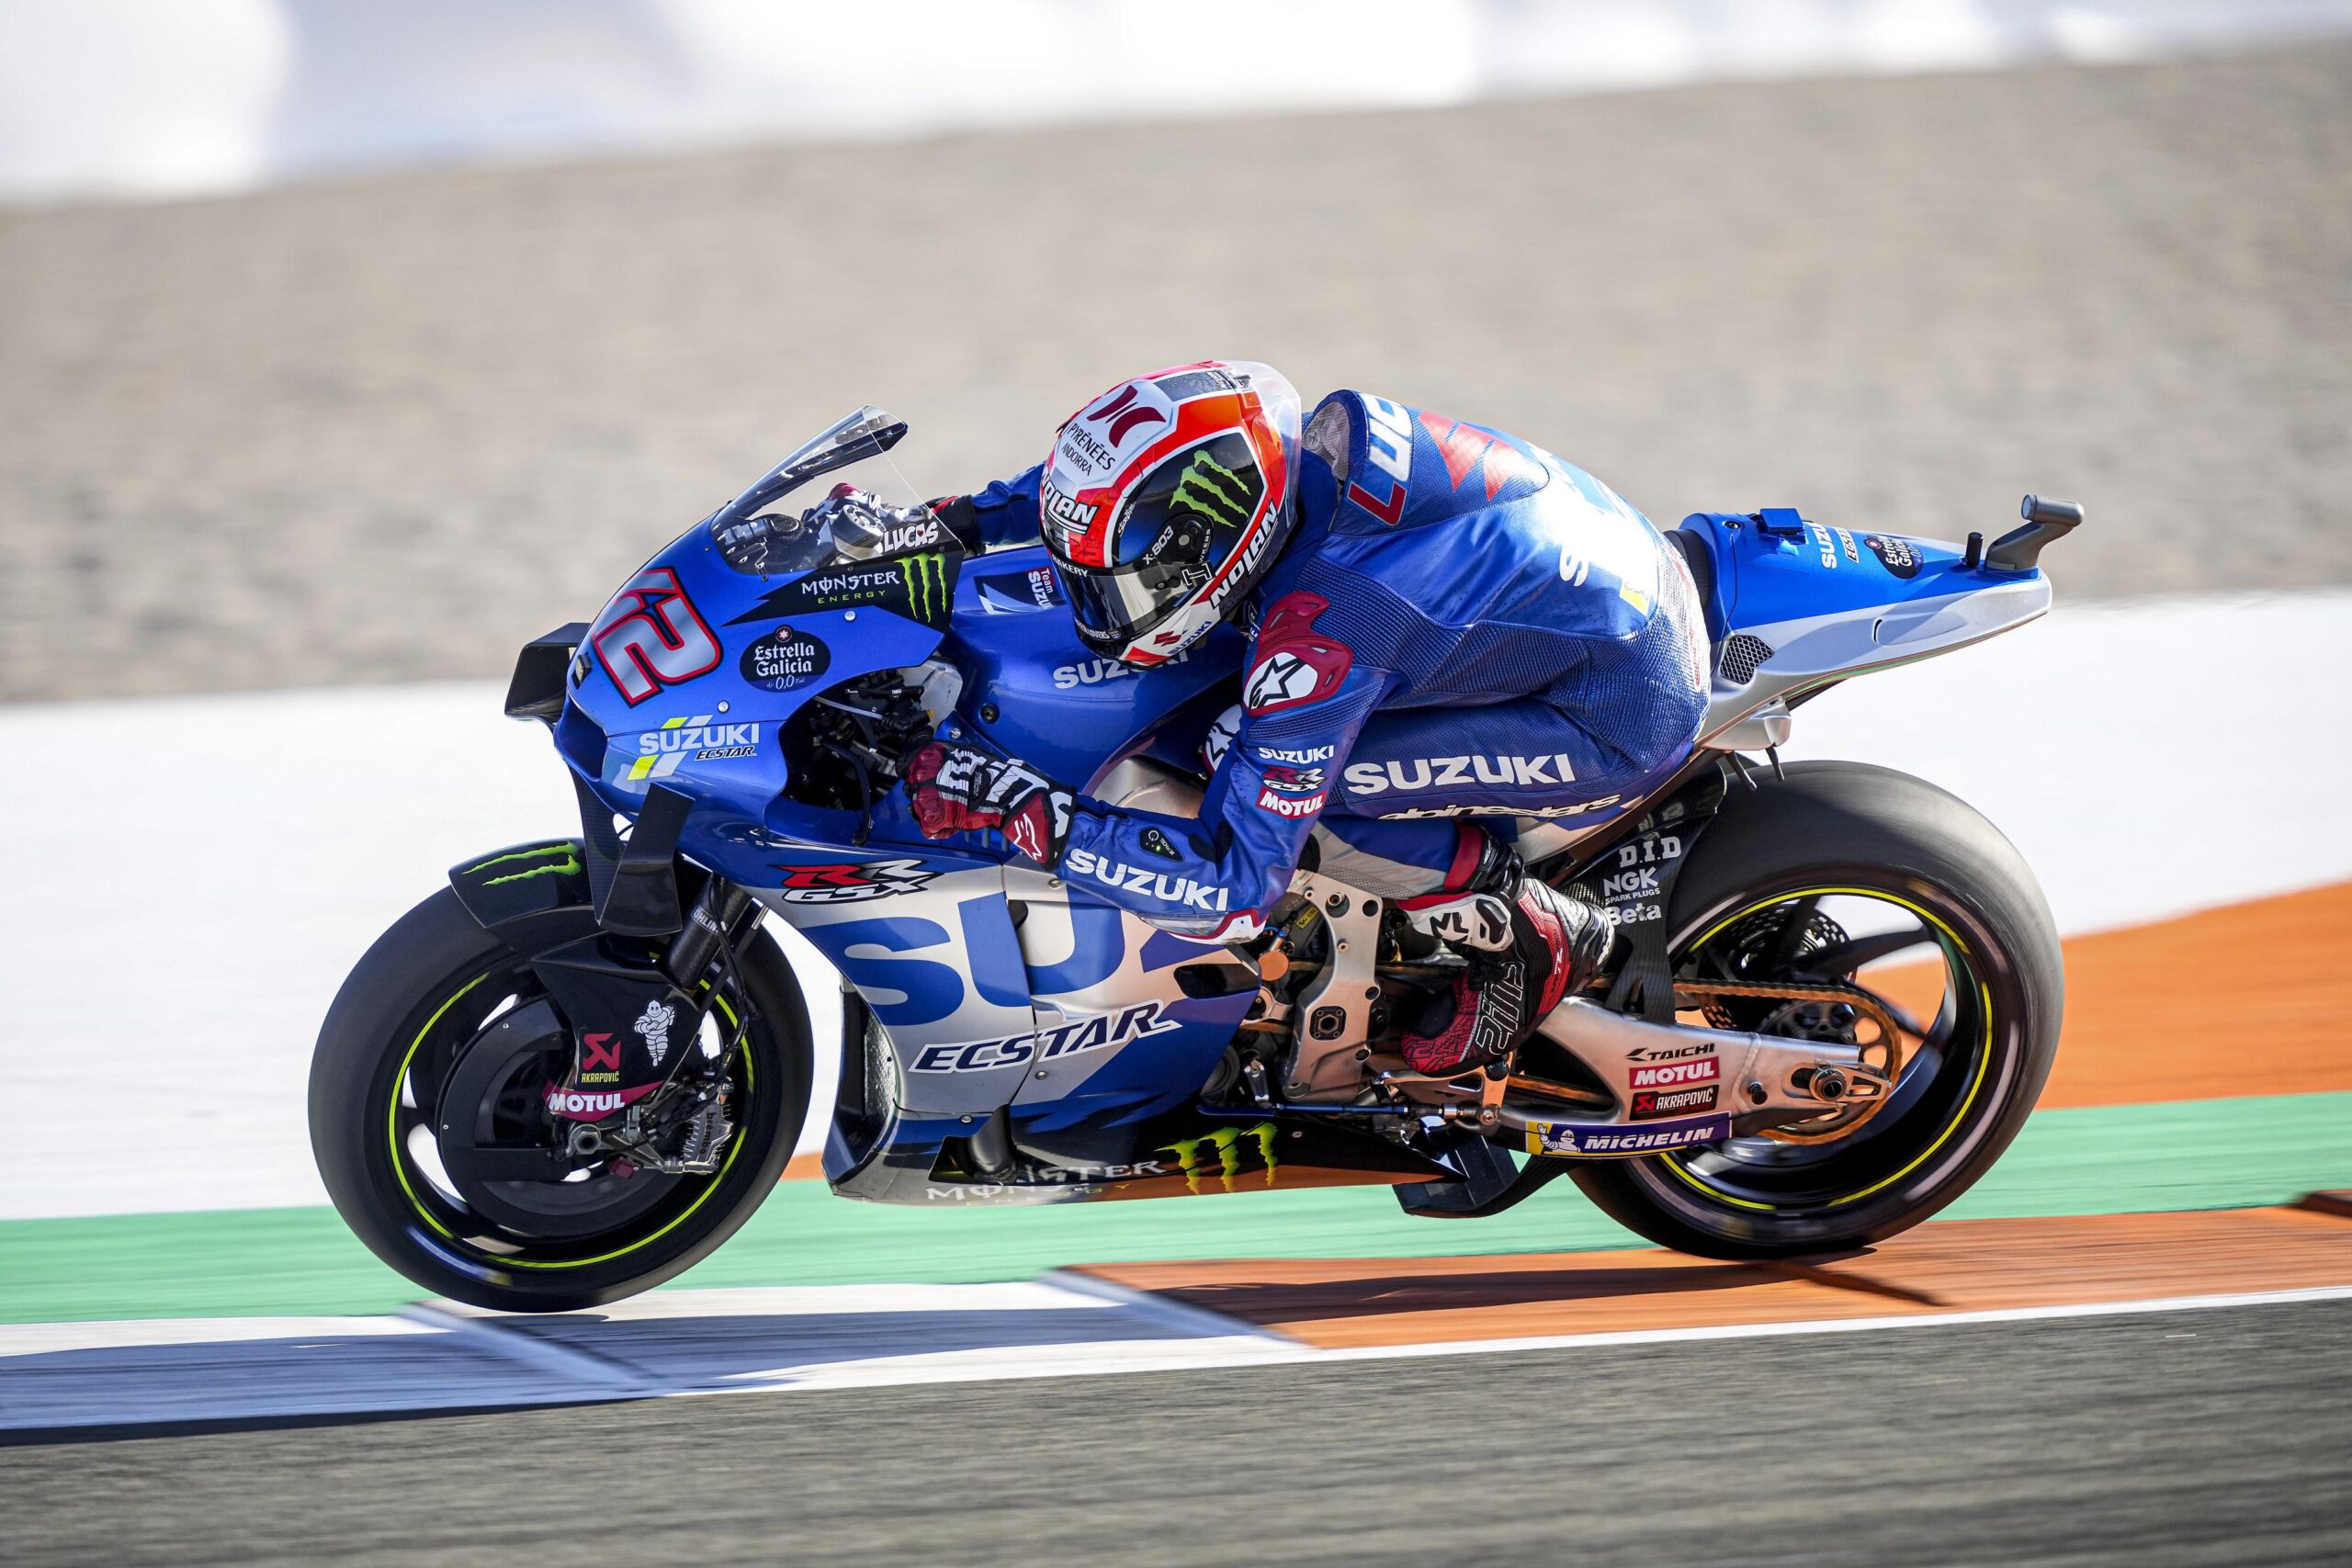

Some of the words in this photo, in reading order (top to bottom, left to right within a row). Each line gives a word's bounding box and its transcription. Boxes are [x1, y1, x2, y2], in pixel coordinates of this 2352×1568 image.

[1060, 442, 1092, 477] ANDORRA
[883, 521, 939, 553] LUCAS
[1806, 521, 1838, 570] SUZU
[1208, 501, 1278, 609] NOLAN
[801, 570, 900, 596] MONSTER
[1040, 568, 1054, 594] Team
[818, 590, 886, 604] ENERGY
[753, 642, 816, 661] Estrella
[756, 657, 813, 677] Galicia
[775, 674, 795, 690] 0,0
[639, 722, 760, 755] SUZUKI
[694, 745, 758, 761] ECSTAR
[1258, 745, 1335, 764] SUZUKI
[1343, 753, 1577, 795] SUZUKI
[1259, 792, 1324, 817] MOTUL
[1066, 848, 1229, 912] SUZUKI
[1603, 866, 1659, 897] NGK
[1604, 893, 1632, 906] SPARK
[1632, 887, 1661, 899] PLUGS
[1603, 902, 1662, 926] Beta
[910, 999, 1179, 1073] ECSTAR
[1646, 1043, 1715, 1060] TAICHI
[581, 1071, 620, 1083] AKRAPOVIČ
[1634, 1061, 1715, 1086] MOTUL
[548, 1092, 626, 1112] MOTUL
[1656, 1087, 1714, 1111] AKRAPOVIČ
[698, 1111, 718, 1156] brembo
[1584, 1126, 1714, 1150] MICHELIN
